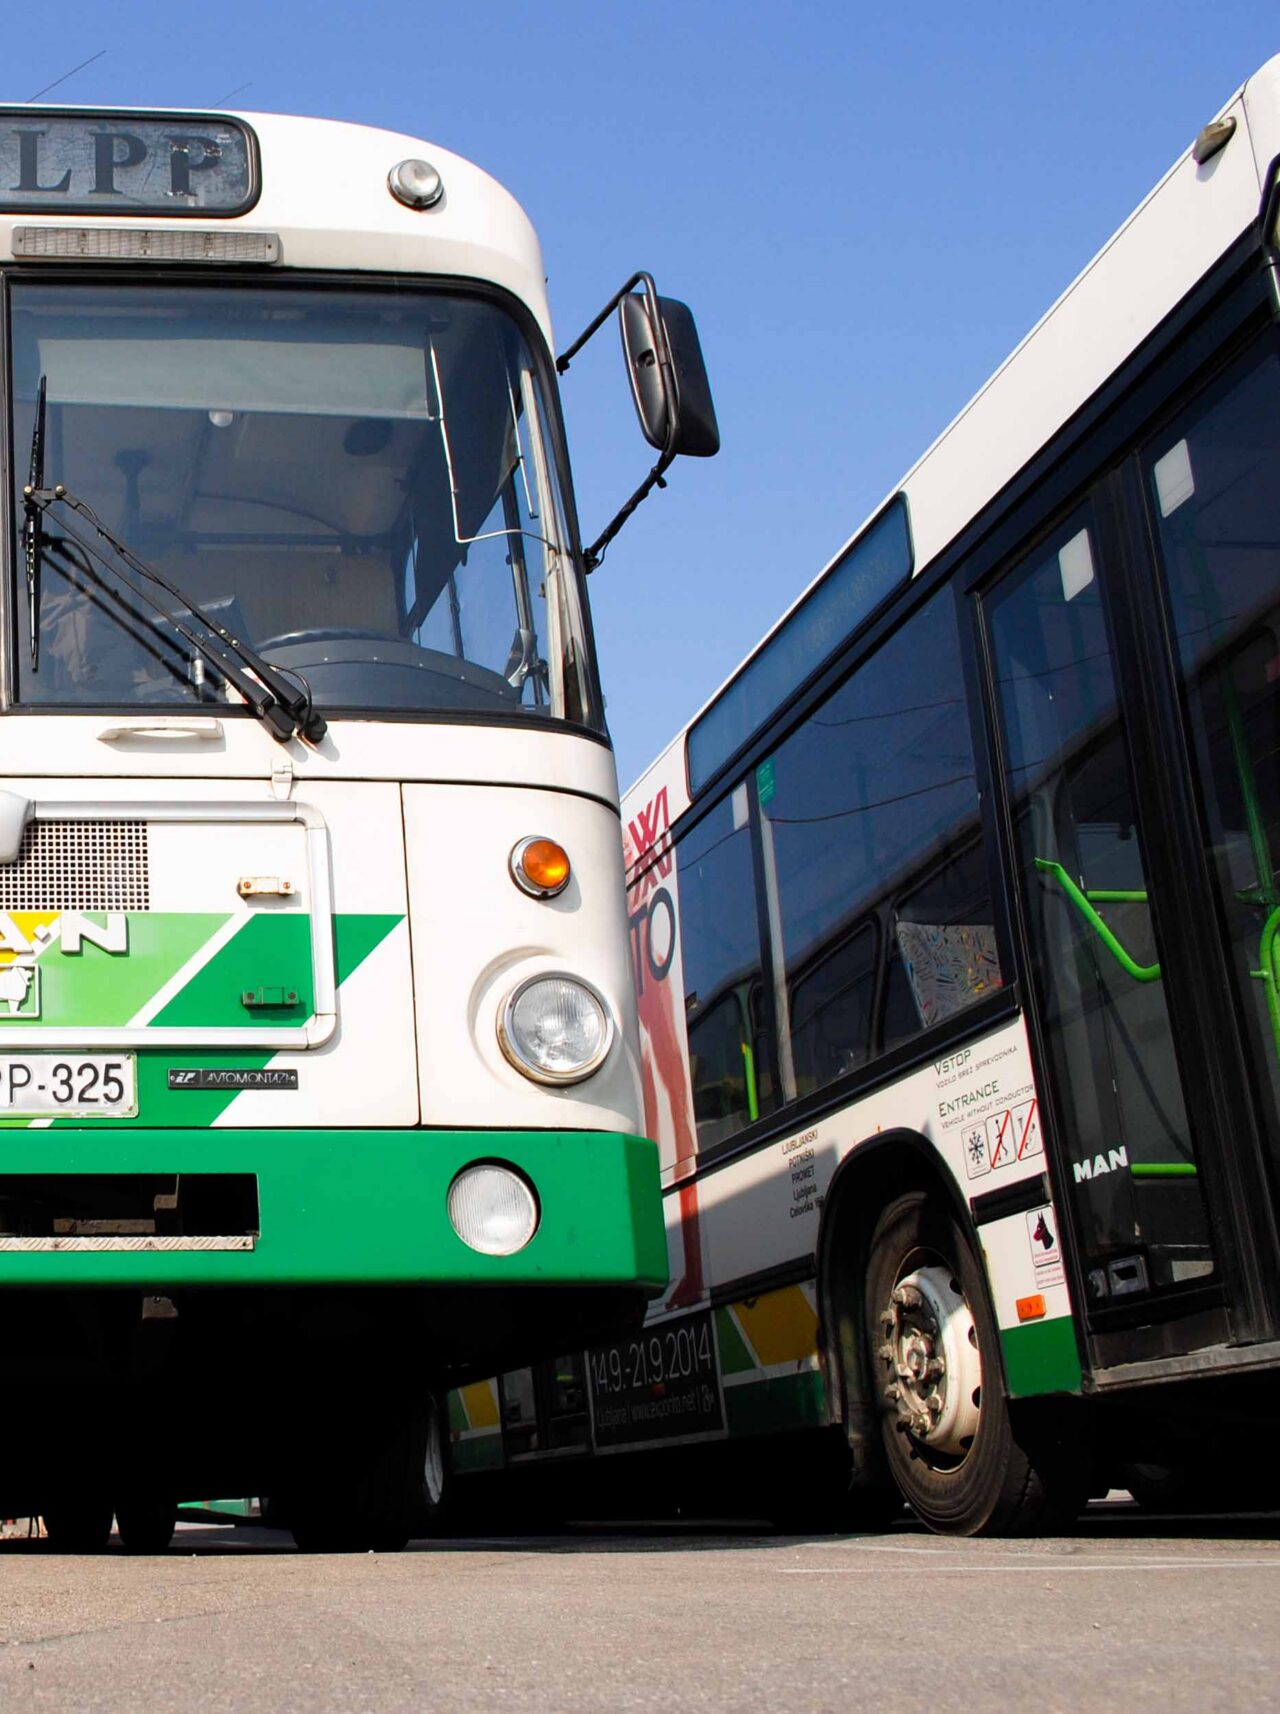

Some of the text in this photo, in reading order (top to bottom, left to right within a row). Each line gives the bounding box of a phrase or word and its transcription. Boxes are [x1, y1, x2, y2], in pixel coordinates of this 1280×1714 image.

[10, 128, 222, 198] LPP
[938, 1080, 1000, 1118] ENTRANCE
[1073, 1145, 1128, 1183] MAN
